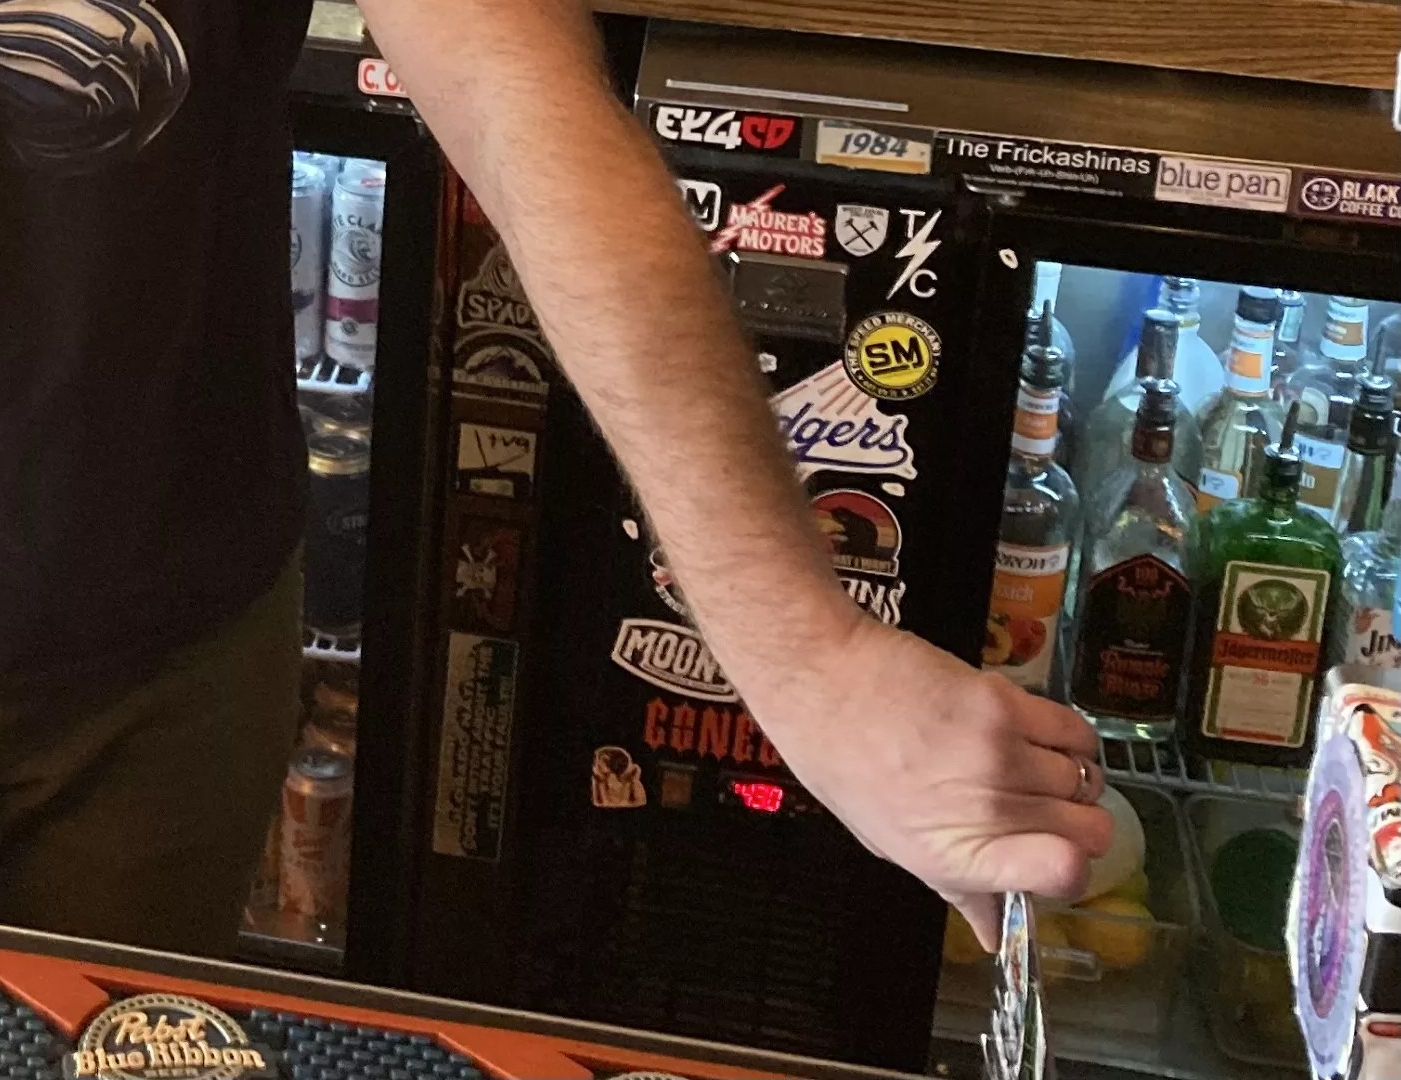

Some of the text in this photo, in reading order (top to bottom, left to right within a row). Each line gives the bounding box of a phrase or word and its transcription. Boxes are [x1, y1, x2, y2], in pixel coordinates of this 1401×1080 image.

[838, 132, 911, 159] 1984
[947, 137, 1154, 176] The Frickashinas
[1159, 160, 1284, 204] blue pan
[1341, 180, 1401, 205] BLACK
[727, 201, 828, 235] MAURER'S
[1339, 199, 1386, 218] COFFEE
[739, 230, 826, 258] MOTORS
[863, 335, 926, 370] SM
[621, 627, 728, 684] MOON
[111, 1010, 208, 1045] Pabst
[73, 1041, 266, 1076] Blue Ribbon
